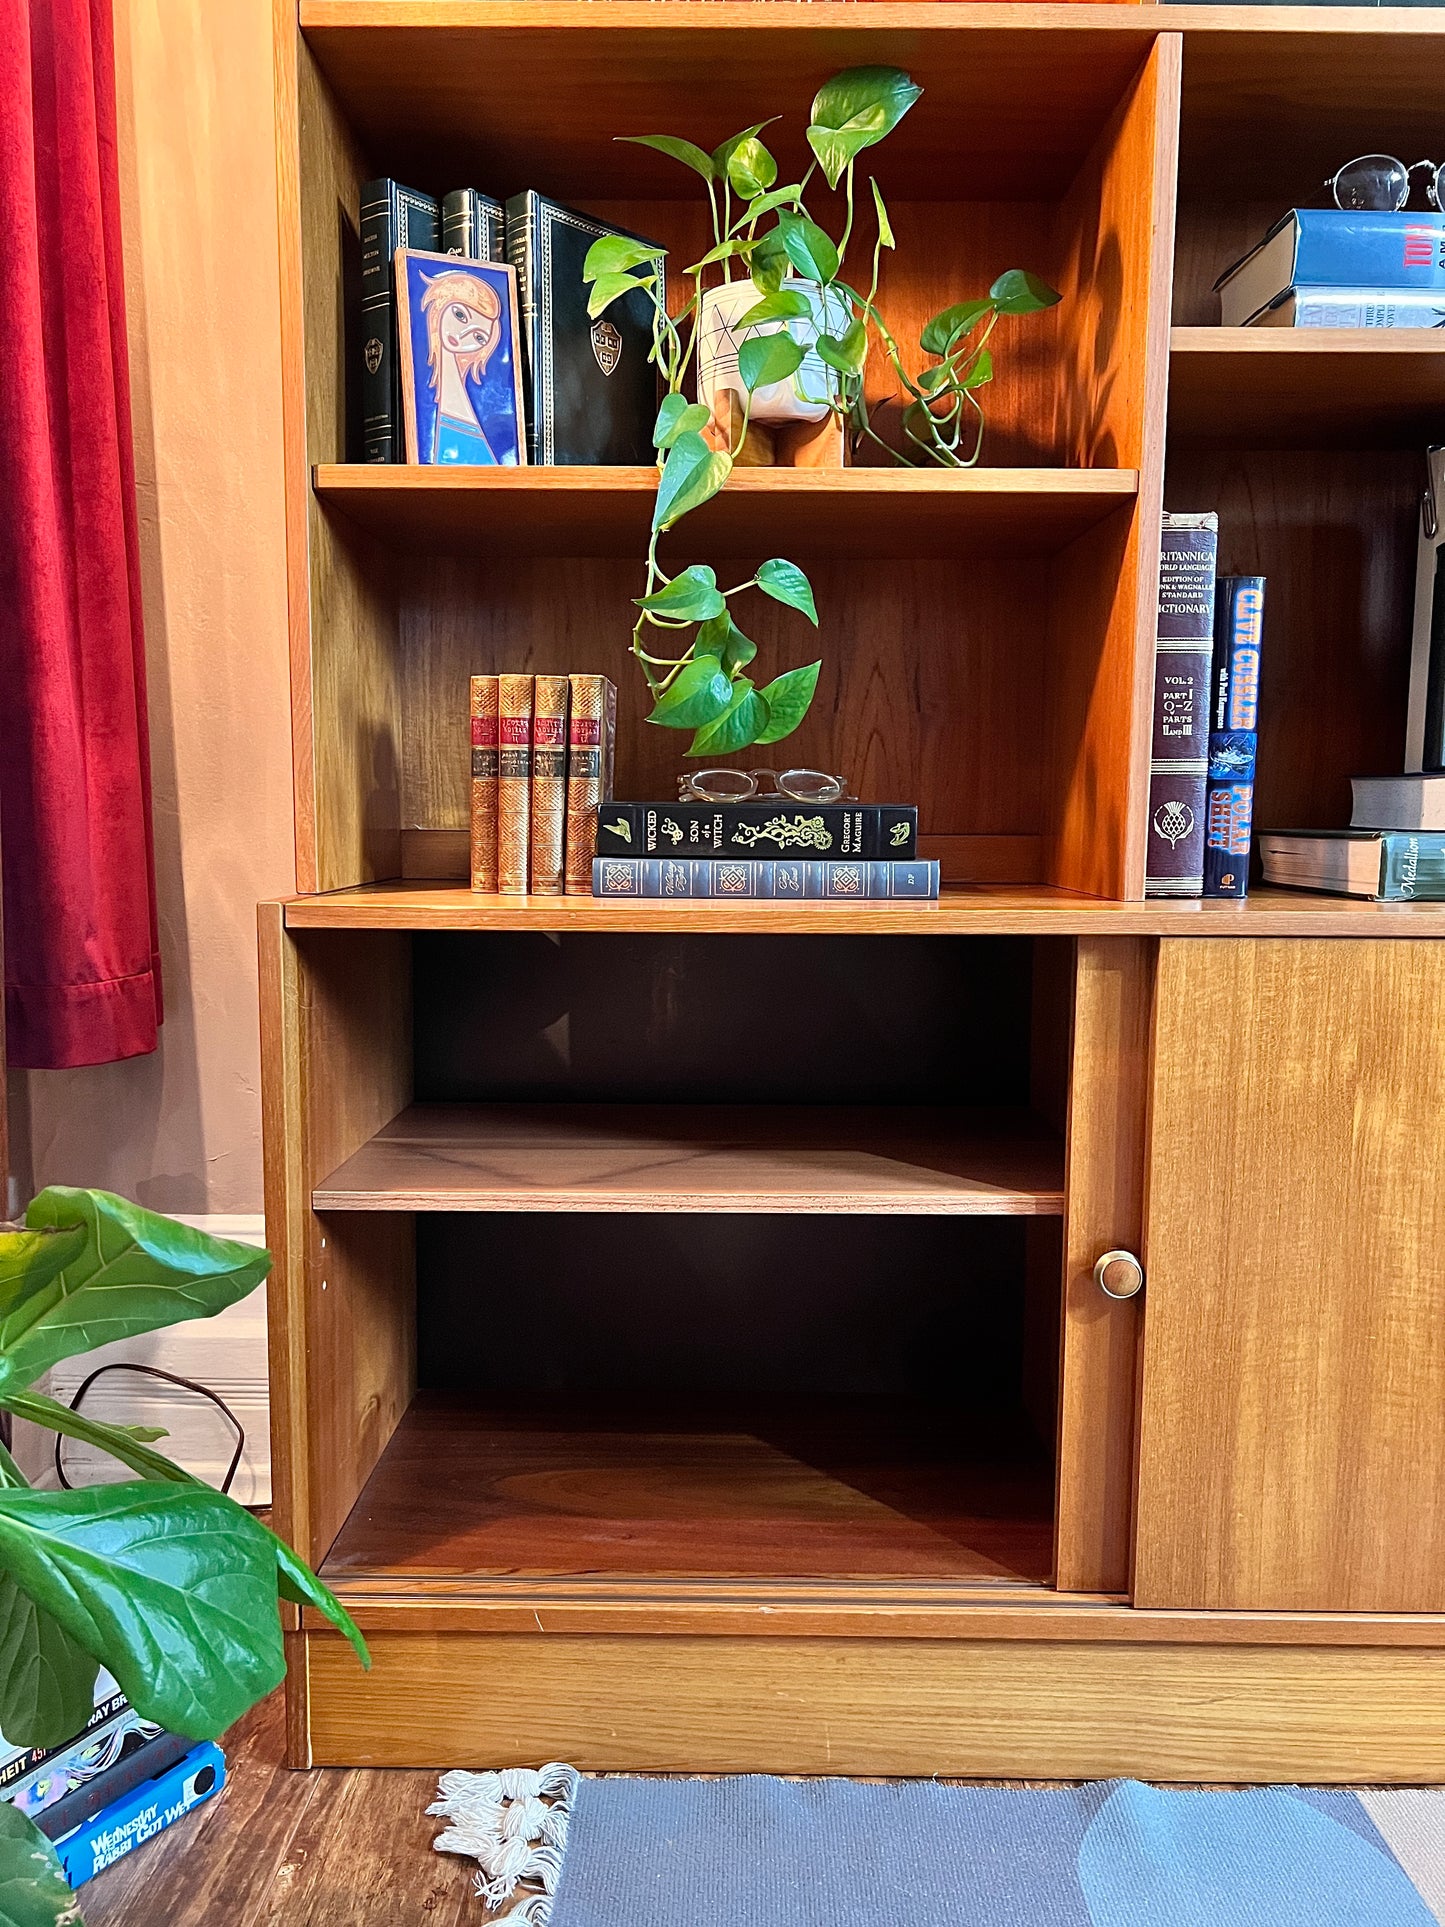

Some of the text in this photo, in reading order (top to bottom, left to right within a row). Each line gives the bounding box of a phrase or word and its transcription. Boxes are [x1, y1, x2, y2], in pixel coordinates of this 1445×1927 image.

[1160, 551, 1214, 562] RITANNICA
[1158, 603, 1211, 614] ICTIONARY
[1229, 588, 1264, 730] CLIVE CUSSLER
[1163, 692, 1188, 700] PART
[1187, 676, 1194, 685] 2
[1218, 682, 1228, 697] Paul
[1162, 715, 1193, 724] PARTS
[647, 810, 657, 852] WICKED
[690, 820, 699, 843] SON
[701, 830, 711, 838] of
[713, 814, 723, 849] WITCH
[841, 812, 851, 853] GREGORY
[852, 811, 862, 853] MAGUIRE
[1207, 789, 1232, 849] SHIFT
[1230, 784, 1254, 855] POLAR
[1400, 837, 1419, 894] Medallion
[92, 1836, 133, 1875] RABBI
[136, 1815, 164, 1844] GOT
